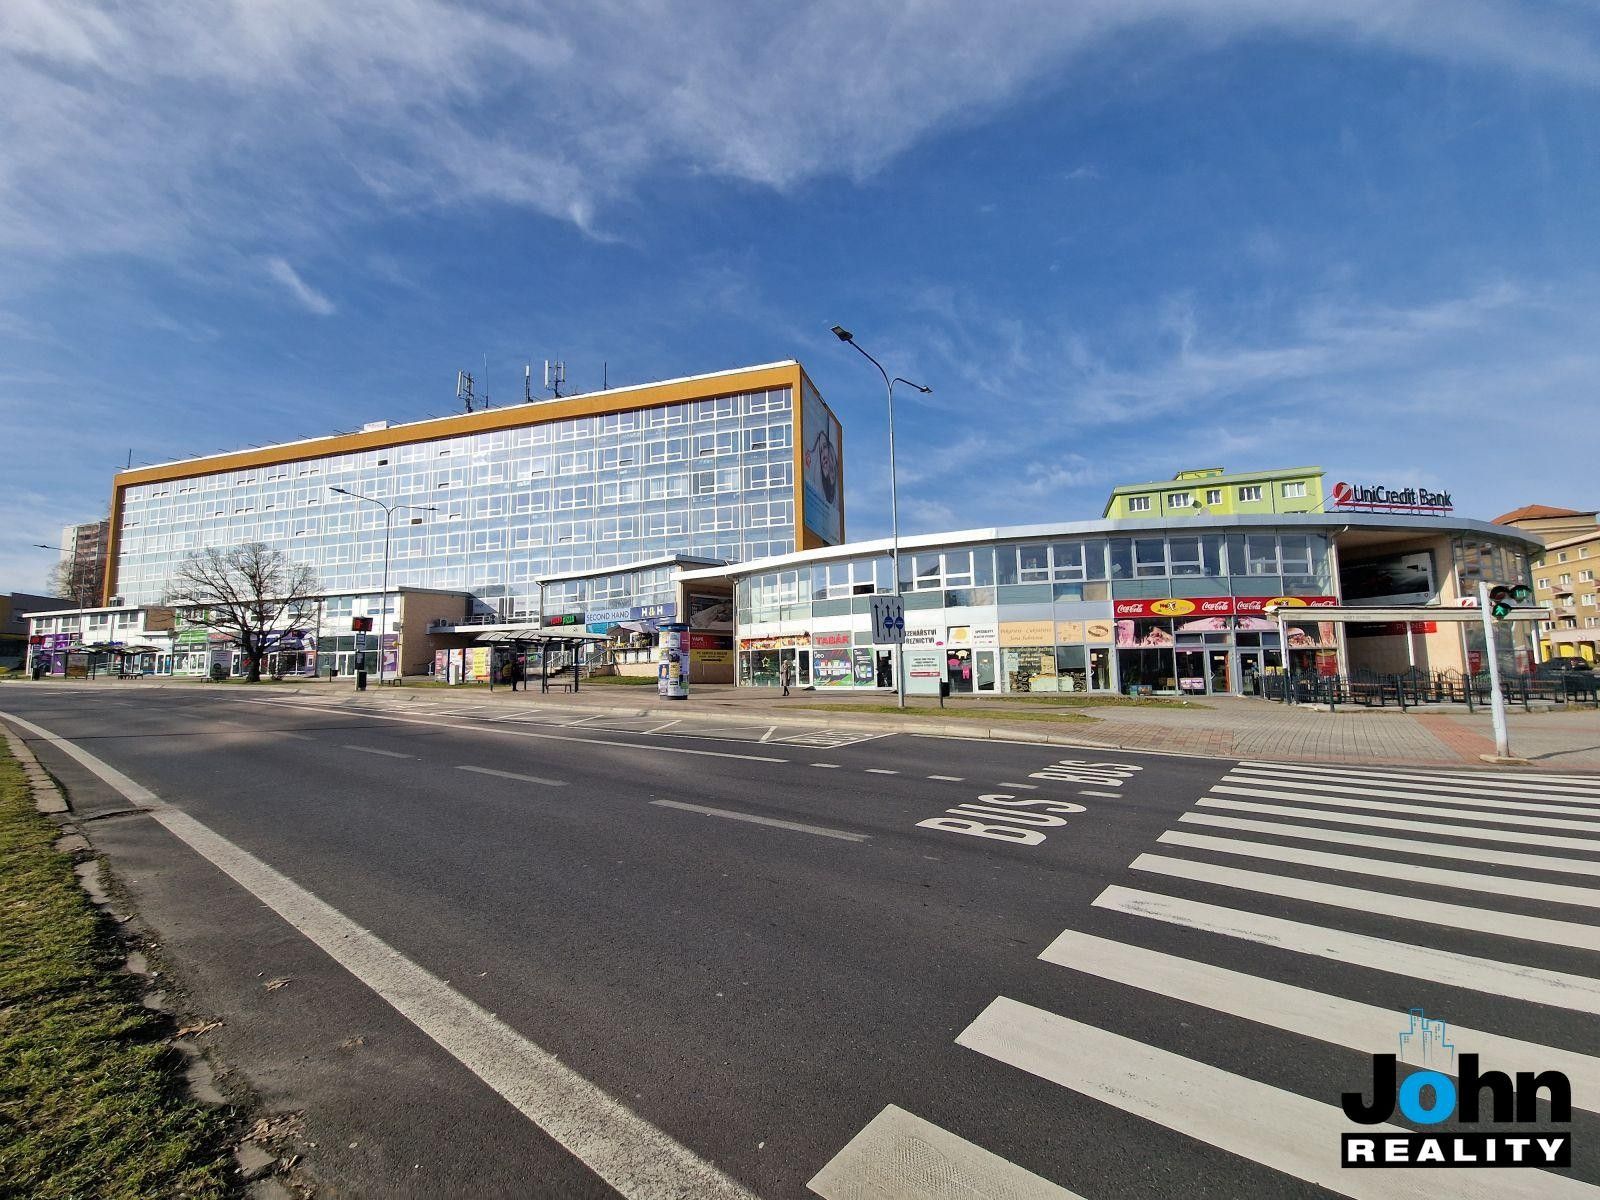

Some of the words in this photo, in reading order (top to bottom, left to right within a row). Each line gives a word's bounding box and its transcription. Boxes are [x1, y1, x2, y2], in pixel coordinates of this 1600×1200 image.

[1353, 484, 1416, 505] UniCredit
[1418, 488, 1453, 507] Bank
[1117, 603, 1144, 614] Coca-Cola
[1201, 600, 1230, 611] Coca-Cola
[1236, 600, 1263, 610] Coca-Cola
[586, 611, 611, 625] SECOND
[611, 609, 630, 620] HAND
[1396, 622, 1429, 631] PLNET
[1028, 759, 1144, 787] BUS
[915, 794, 1087, 846] BUS
